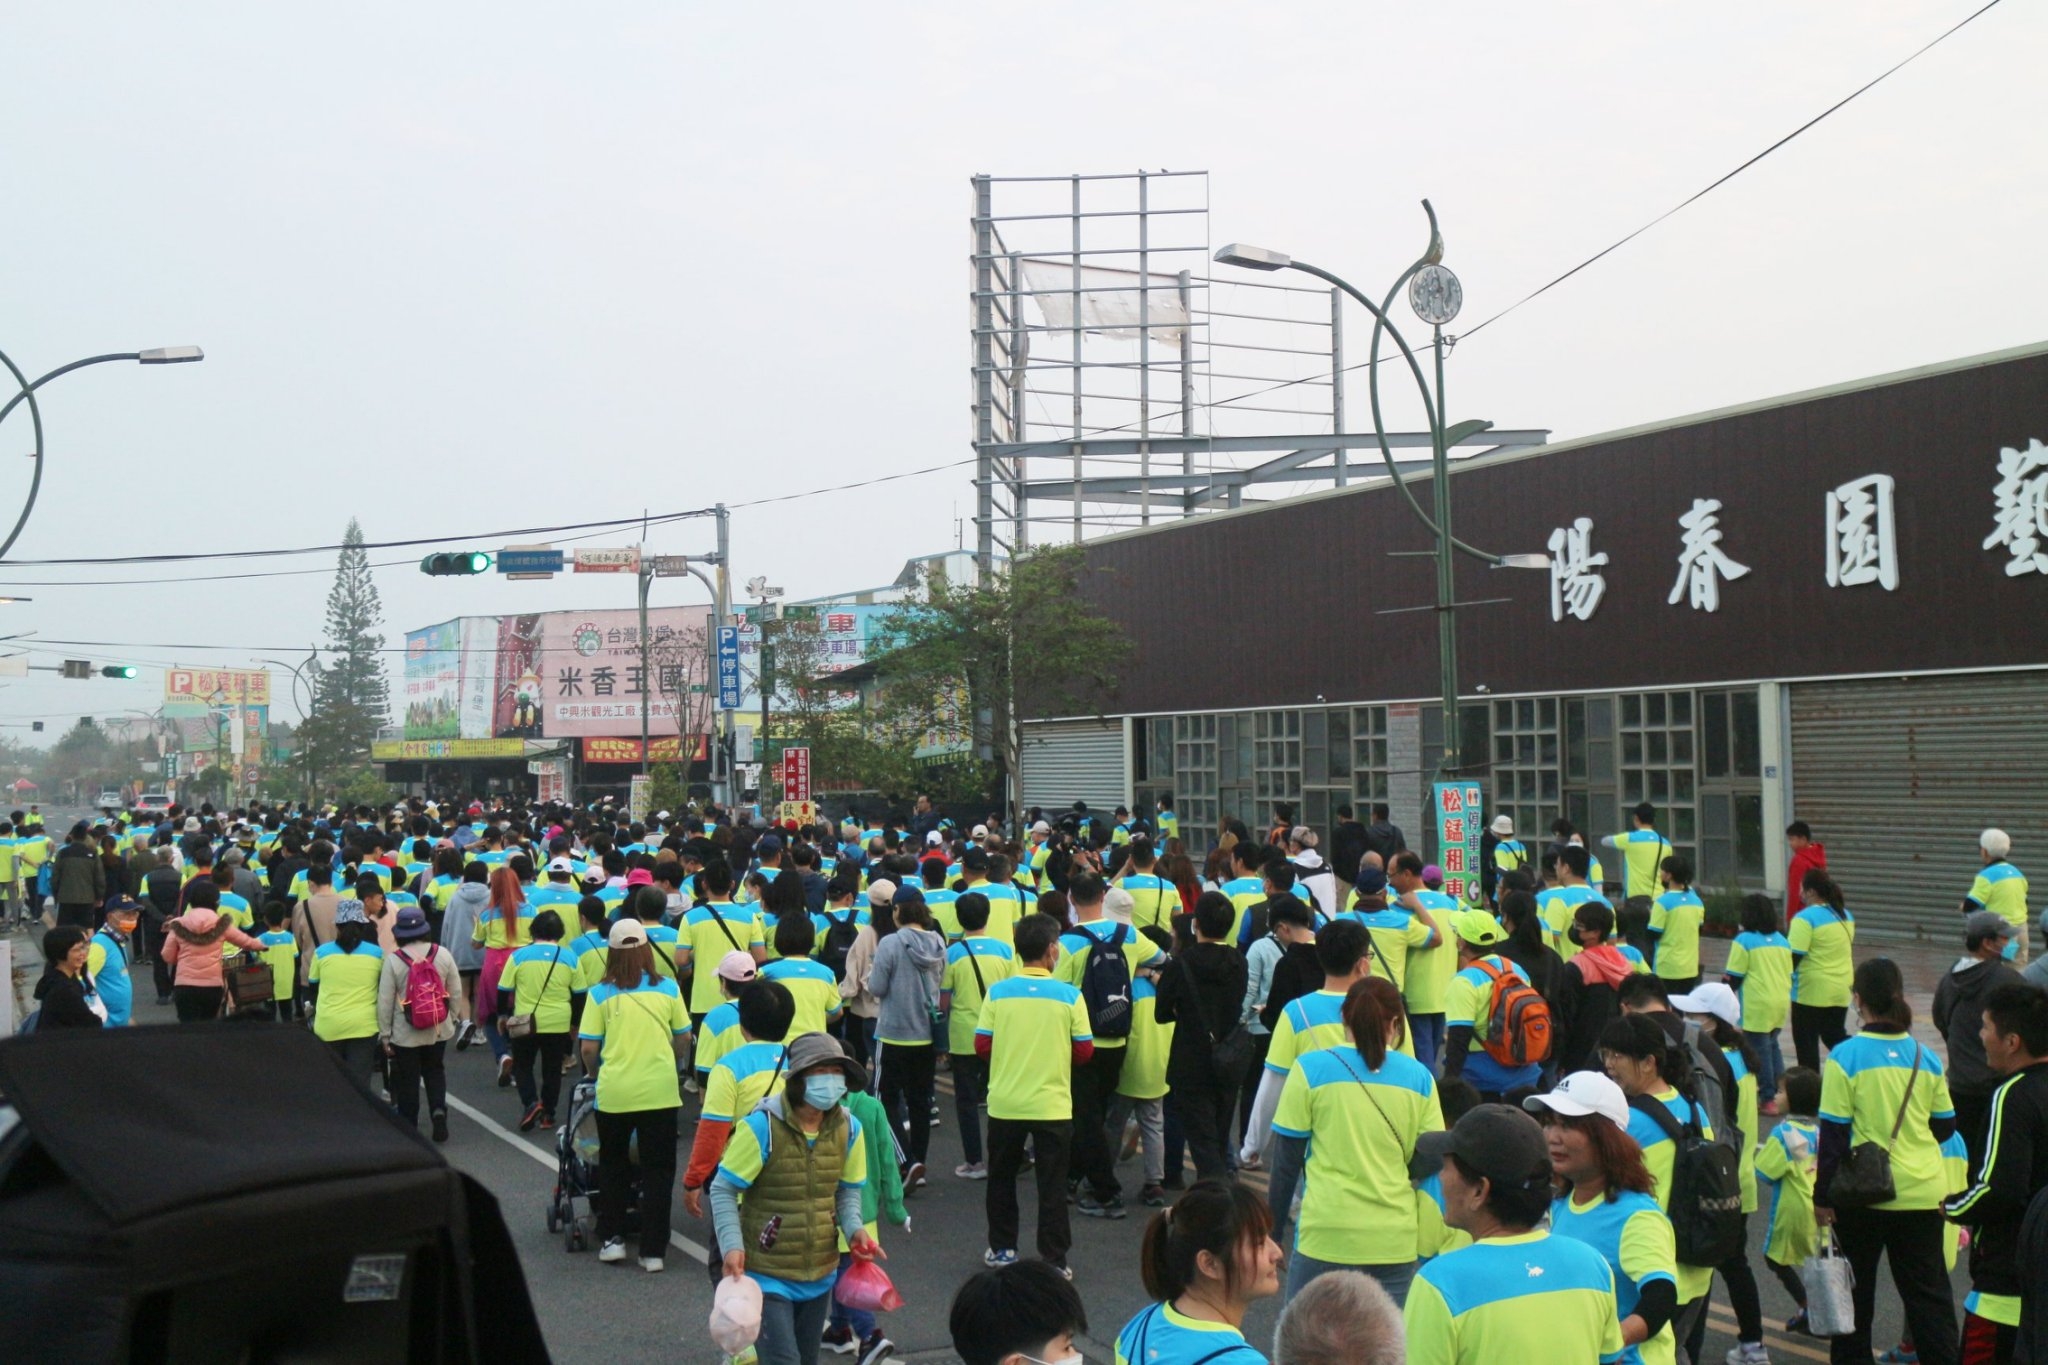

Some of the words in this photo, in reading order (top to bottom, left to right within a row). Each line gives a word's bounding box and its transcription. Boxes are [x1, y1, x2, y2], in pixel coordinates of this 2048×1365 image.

[721, 629, 733, 644] P
[174, 673, 190, 692] P
[559, 665, 686, 696] 米香王國
[721, 658, 738, 706] 停車場
[560, 705, 636, 717] 中興米觀光工廠
[787, 750, 795, 800] 禁止停車
[1468, 811, 1479, 874] 停車場
